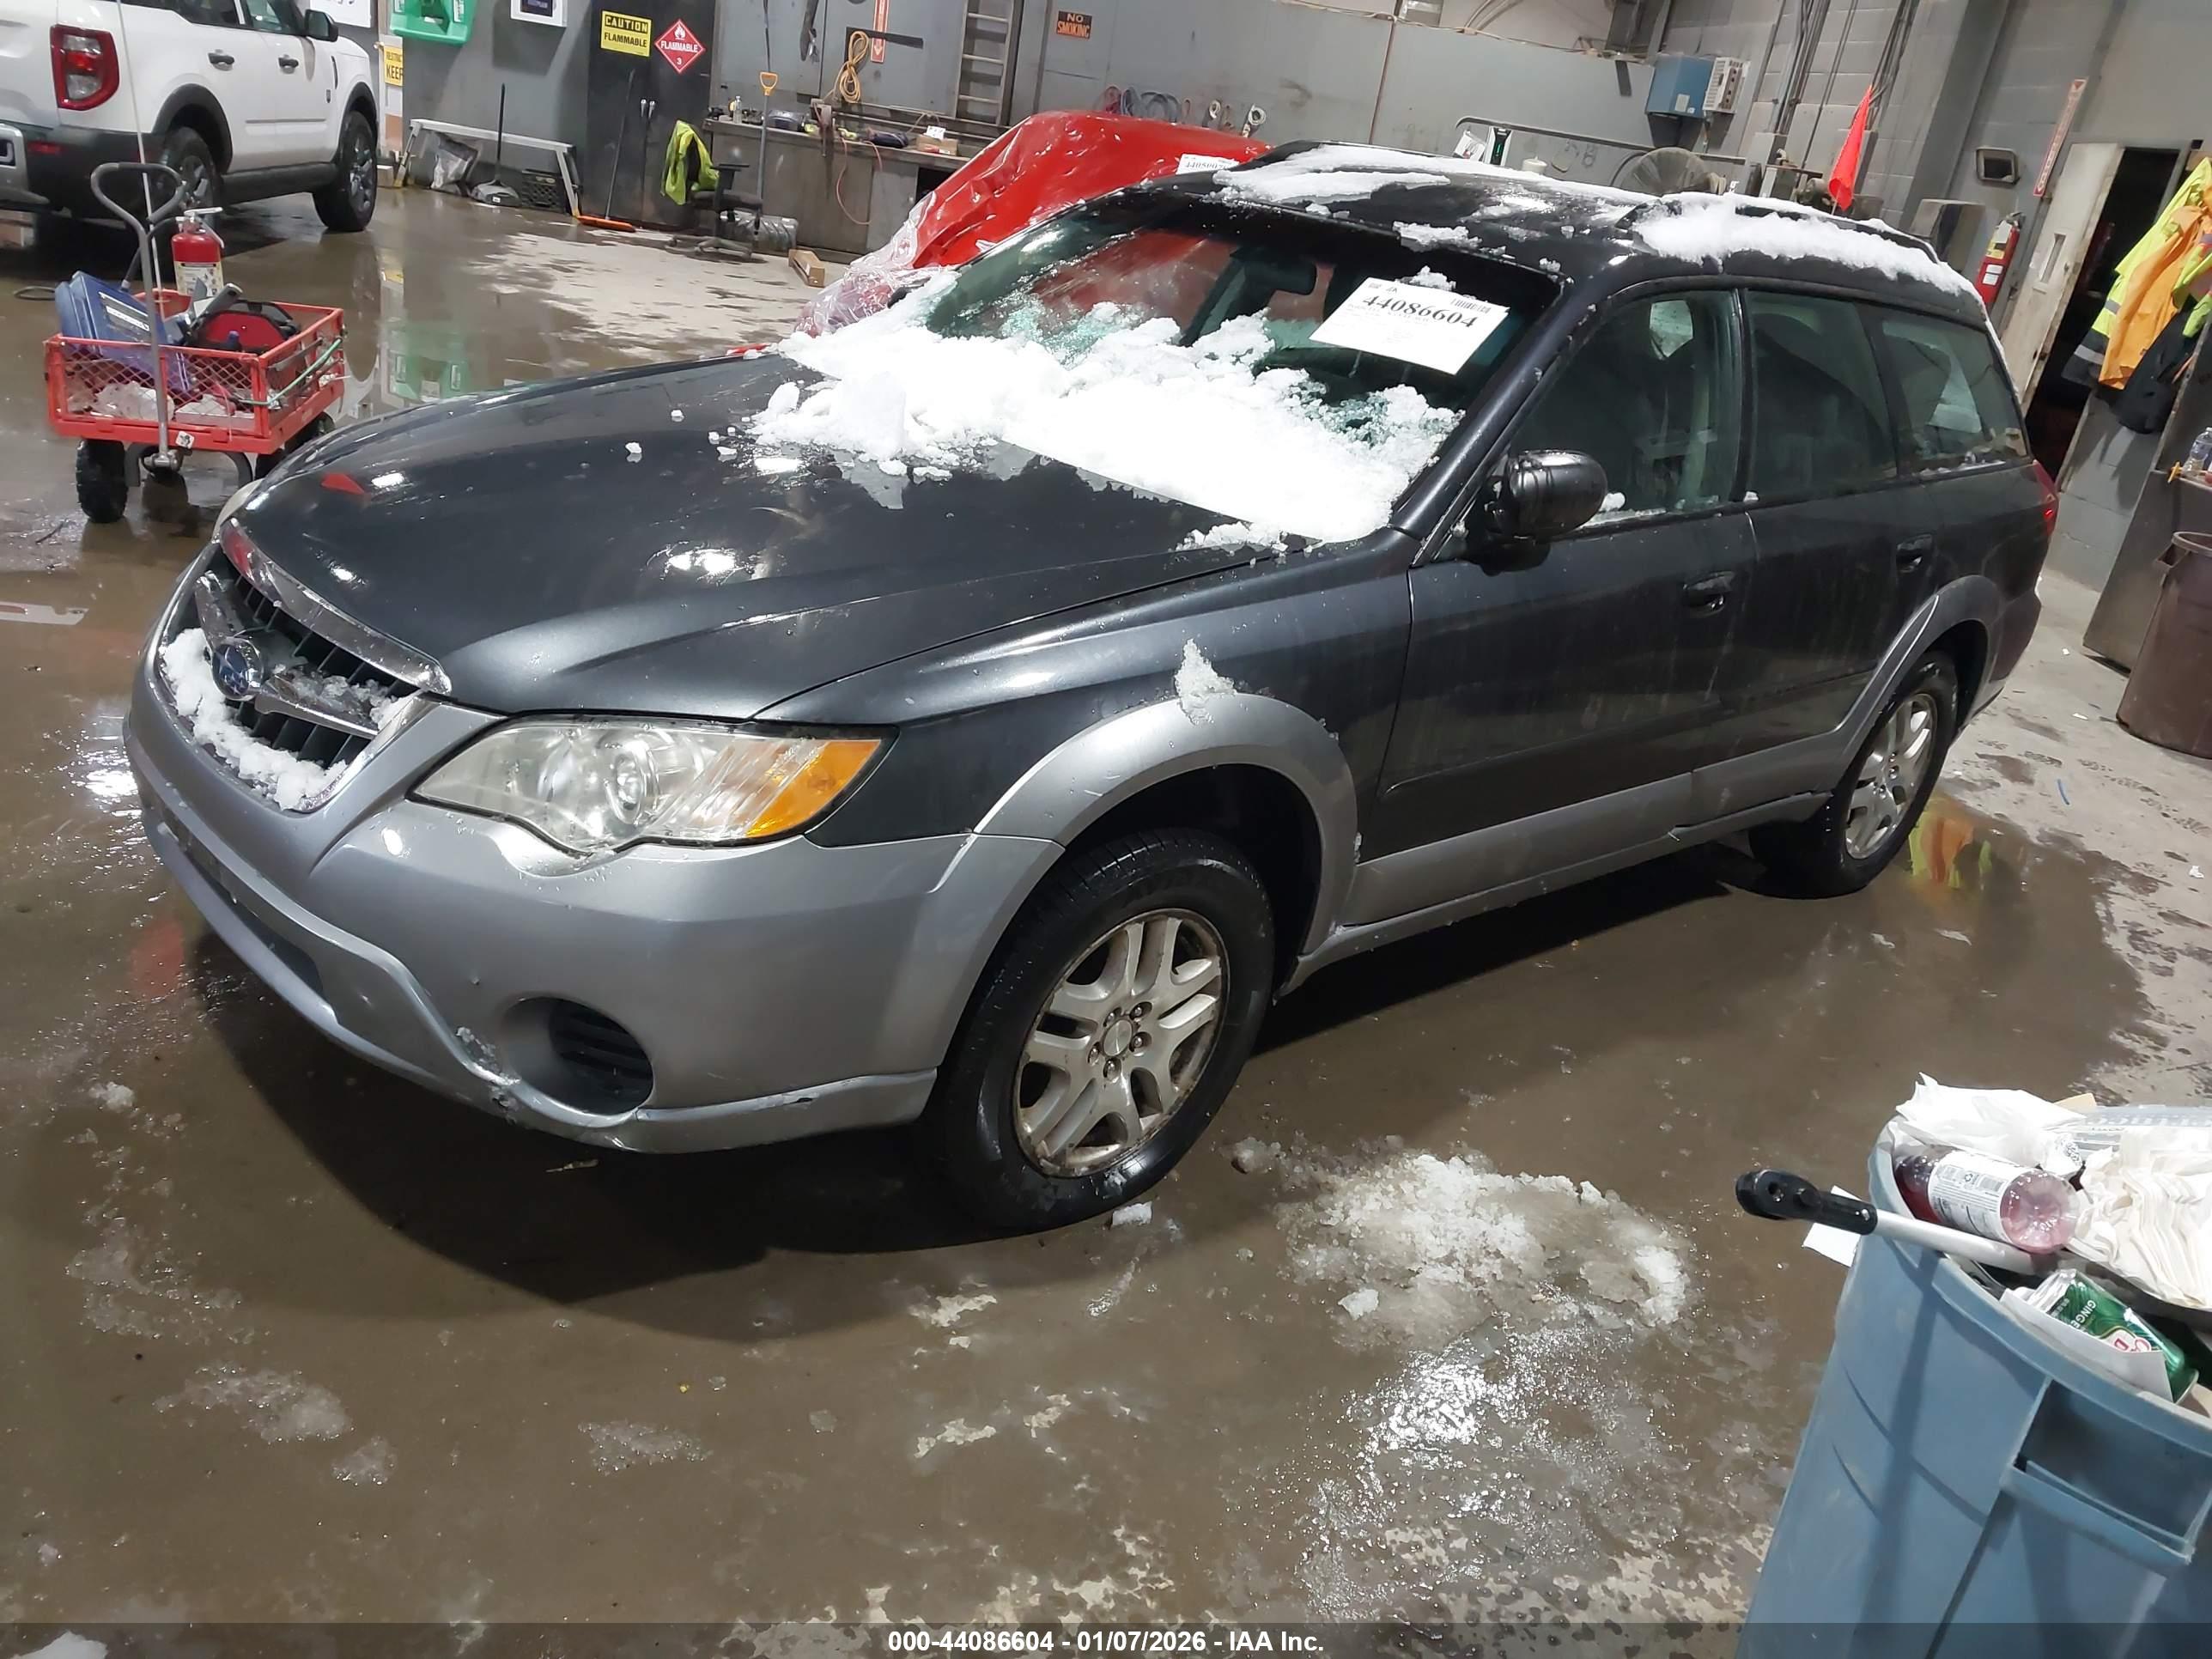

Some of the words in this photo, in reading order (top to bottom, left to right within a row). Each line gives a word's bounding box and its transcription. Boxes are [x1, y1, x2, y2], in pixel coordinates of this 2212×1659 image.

[605, 15, 648, 33] CAUTION
[1066, 13, 1084, 23] NO
[1057, 21, 1091, 38] SMOKING
[604, 32, 647, 48] FLAMMABLE
[660, 40, 698, 52] FLAMMABLE
[1363, 295, 1479, 328] 44086604
